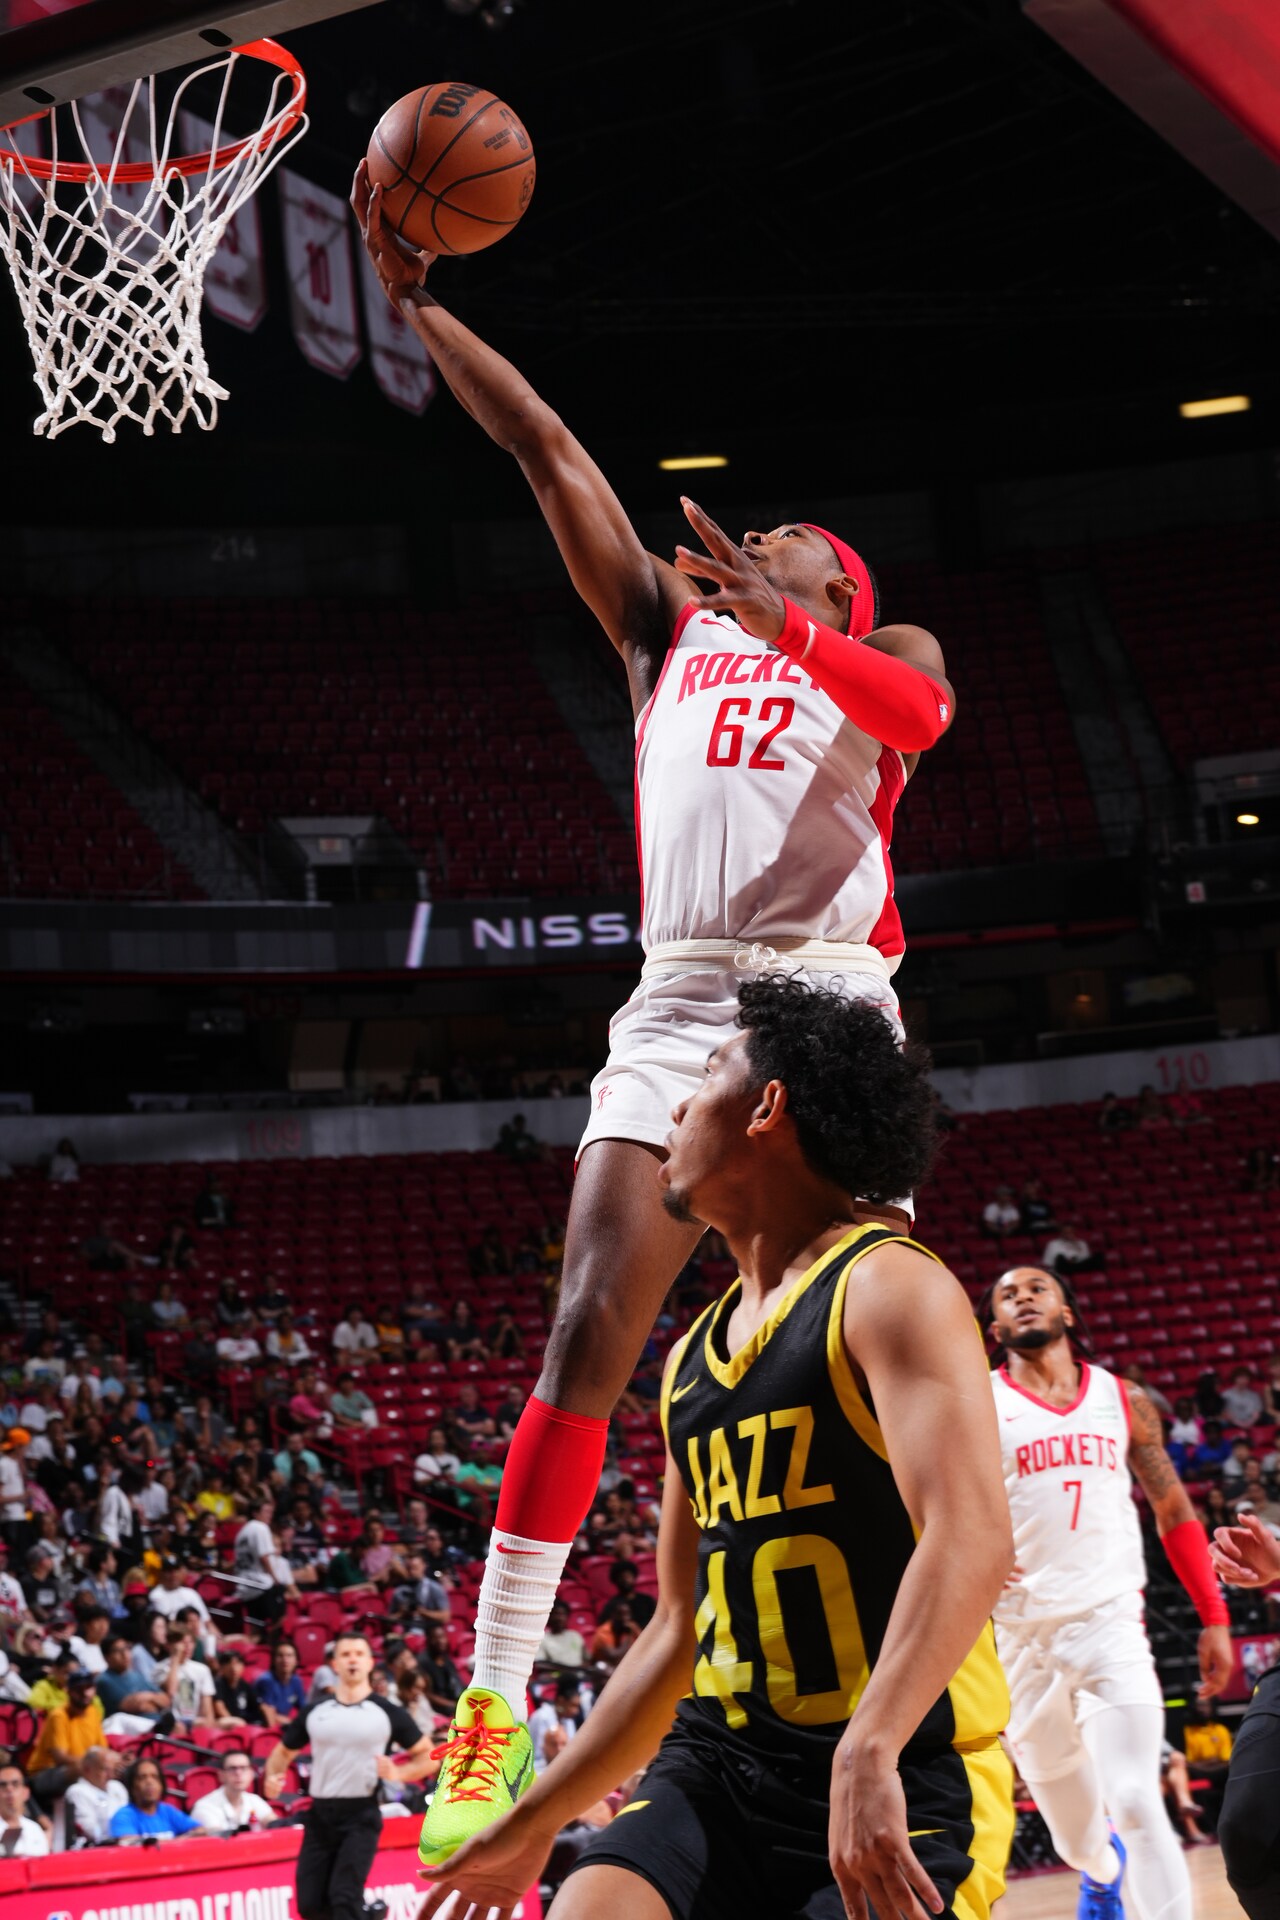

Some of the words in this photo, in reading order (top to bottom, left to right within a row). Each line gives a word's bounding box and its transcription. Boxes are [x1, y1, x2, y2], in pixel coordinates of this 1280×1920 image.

[210, 534, 257, 562] 214
[677, 652, 820, 704] ROCKE
[706, 697, 795, 770] 62
[472, 911, 641, 949] NISS
[1156, 1051, 1210, 1087] 110
[247, 1116, 301, 1153] 109
[685, 1405, 833, 1529] JAZZ
[1015, 1433, 1117, 1478] ROCKETS
[1062, 1480, 1082, 1531] 7
[692, 1533, 870, 1729] 40
